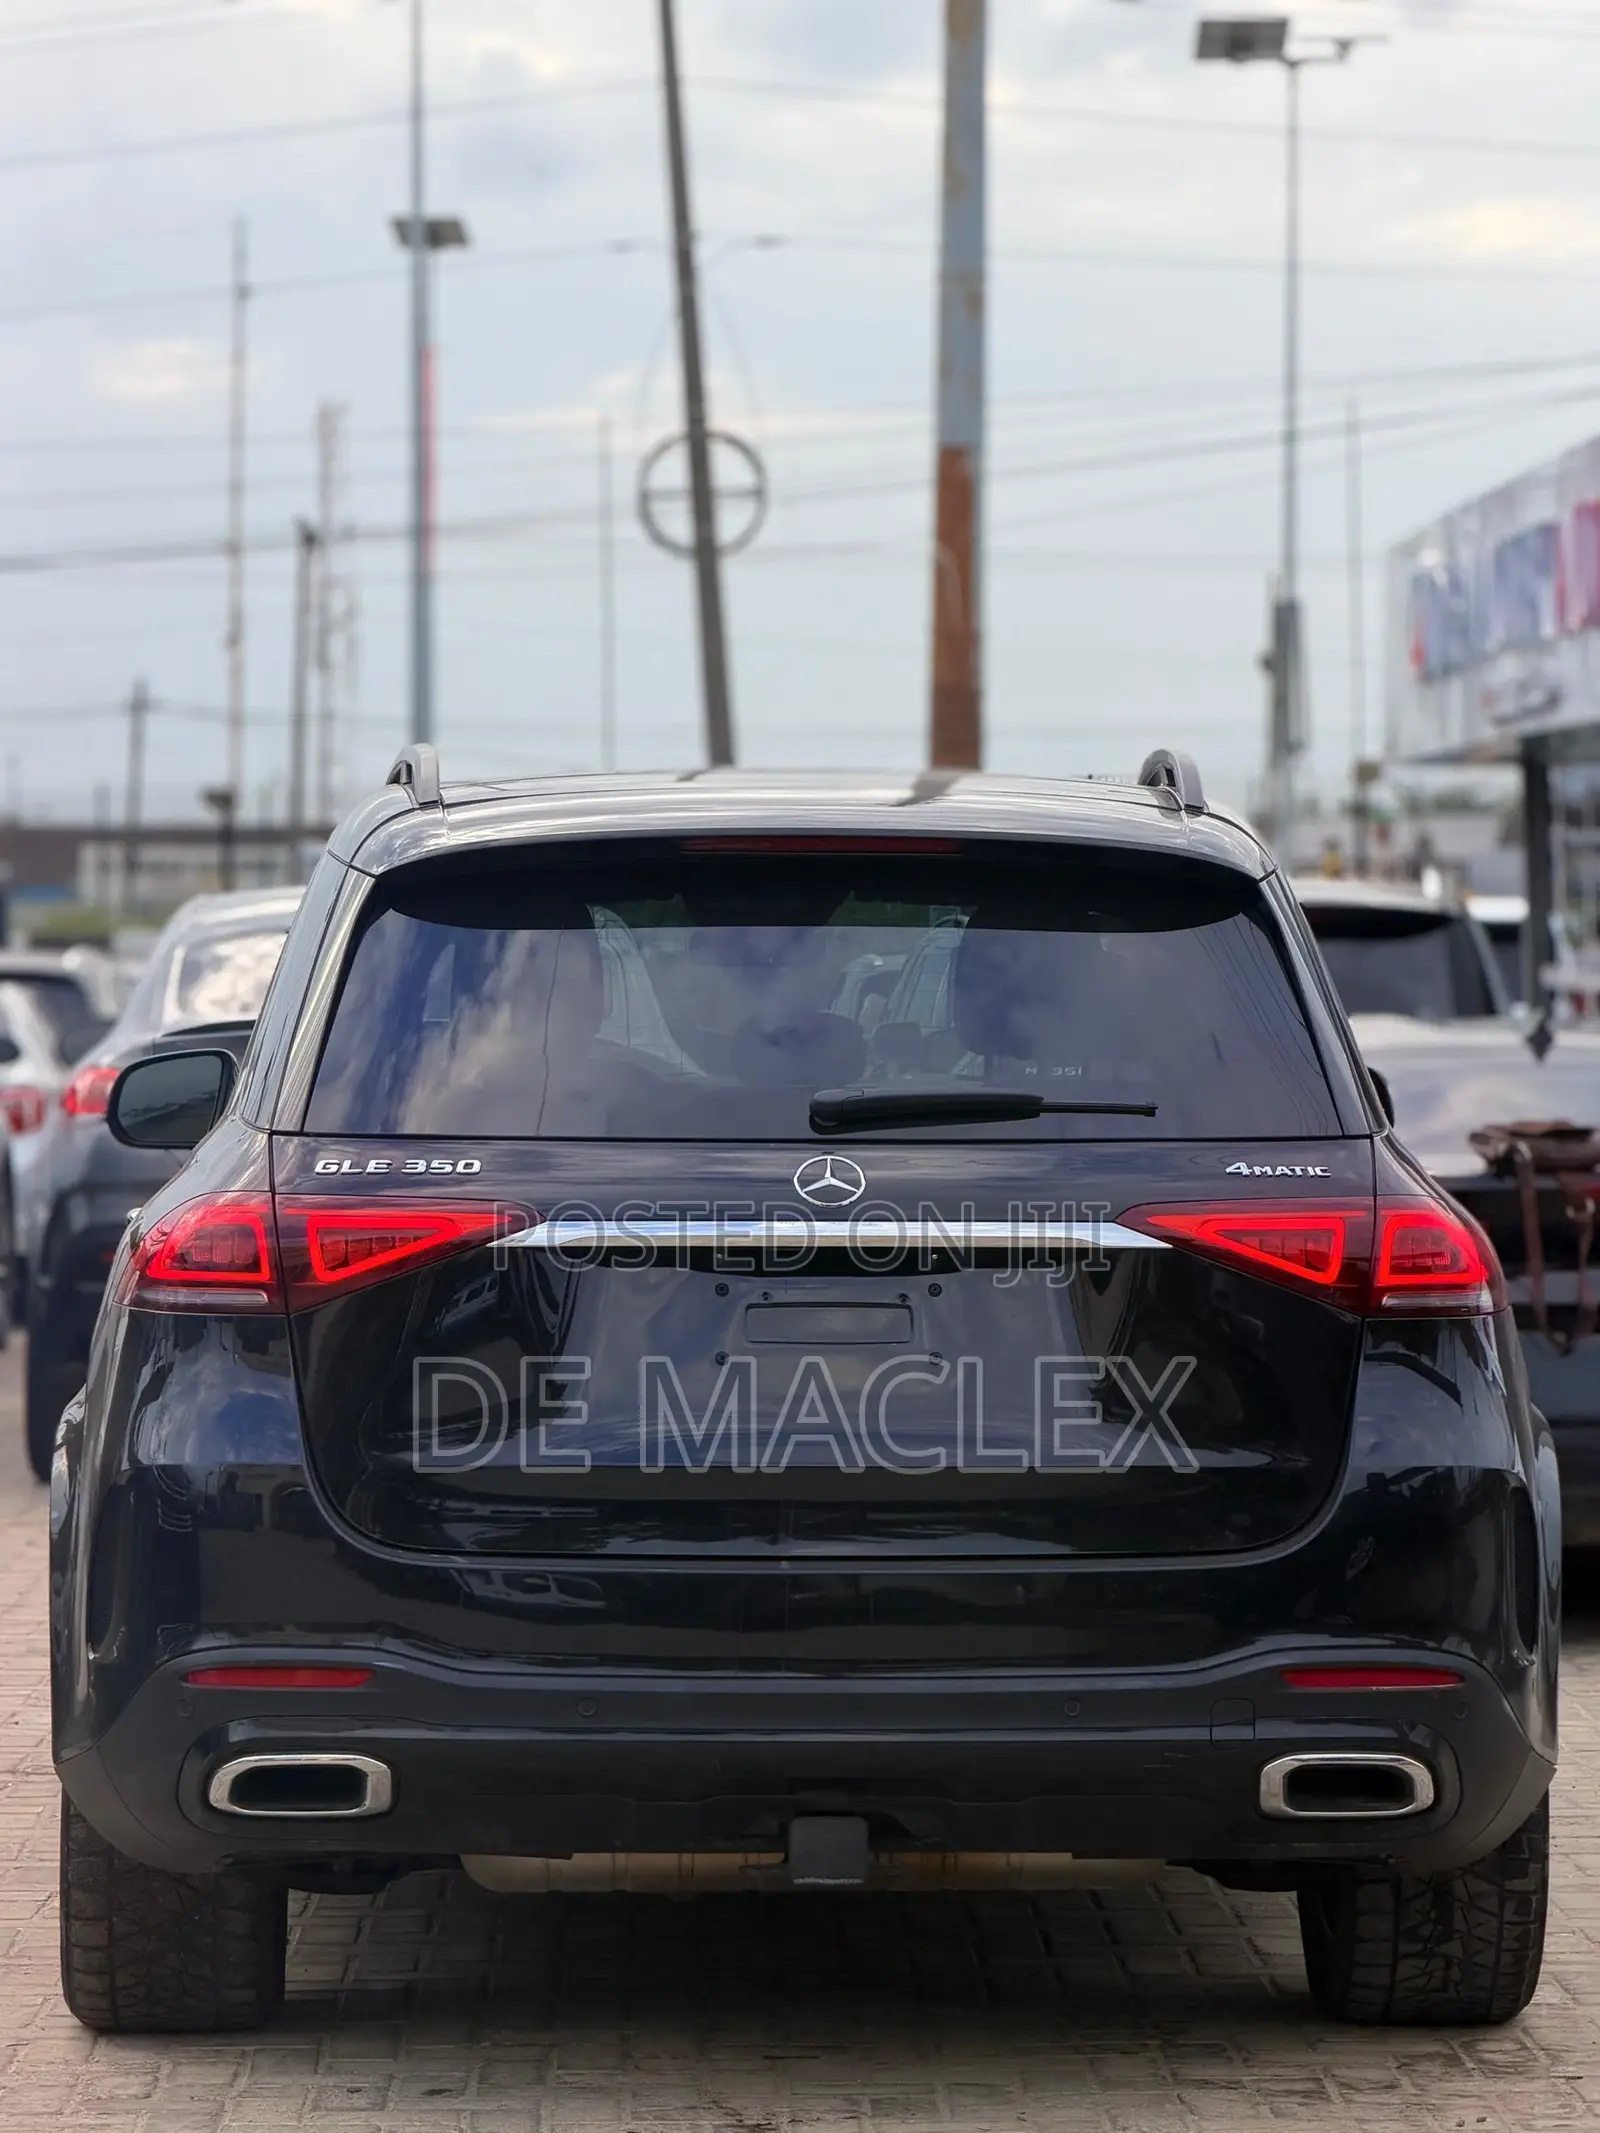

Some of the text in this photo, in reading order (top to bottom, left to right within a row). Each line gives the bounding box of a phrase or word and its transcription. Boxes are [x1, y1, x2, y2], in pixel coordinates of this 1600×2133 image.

[314, 1159, 482, 1175] GLE 350
[1225, 1161, 1332, 1178] 4MATIC
